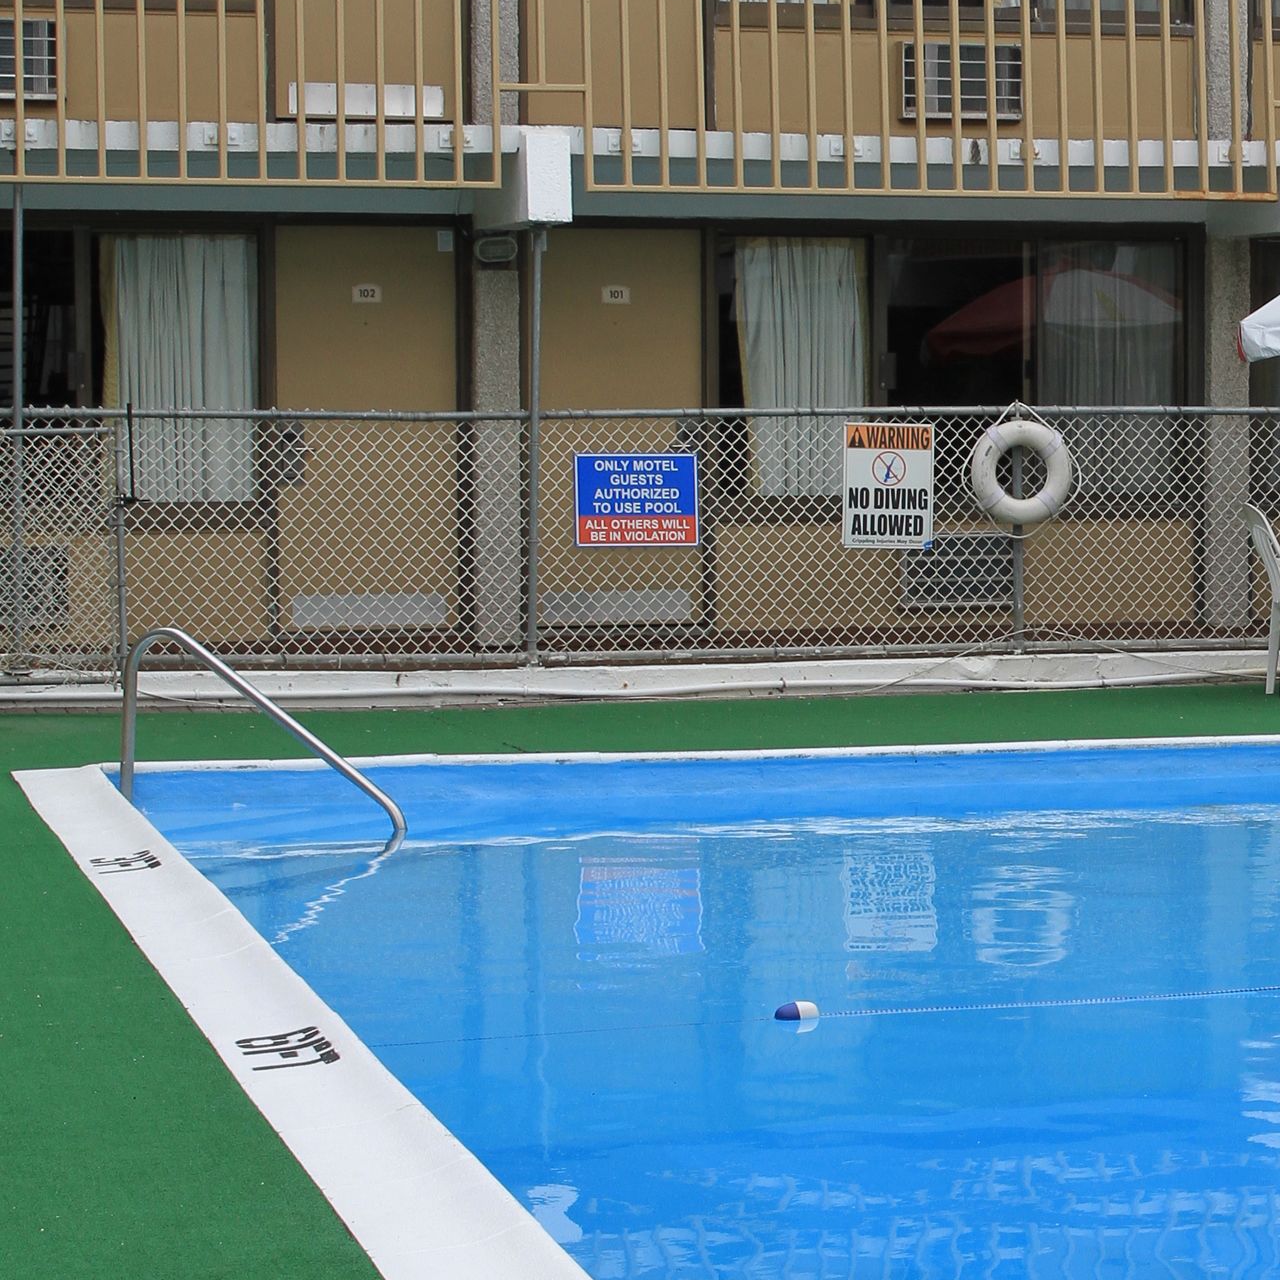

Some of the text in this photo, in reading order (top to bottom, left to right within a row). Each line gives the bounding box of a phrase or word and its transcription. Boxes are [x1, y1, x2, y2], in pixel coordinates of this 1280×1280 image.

[358, 288, 376, 299] 102
[609, 289, 624, 300] 101
[866, 426, 931, 449] WARNING
[594, 460, 679, 471] ONLY MOTEL
[610, 474, 664, 485] GUESTS
[594, 488, 680, 500] AUTHORIZED
[848, 487, 929, 510] NO DIVING
[593, 502, 683, 514] TO USE POOL
[585, 519, 691, 530] ALL OTHERS WILL
[851, 514, 924, 537] ALLOWED
[590, 531, 686, 542] BE IN VIOLATION
[235, 1026, 341, 1071] 6FT
